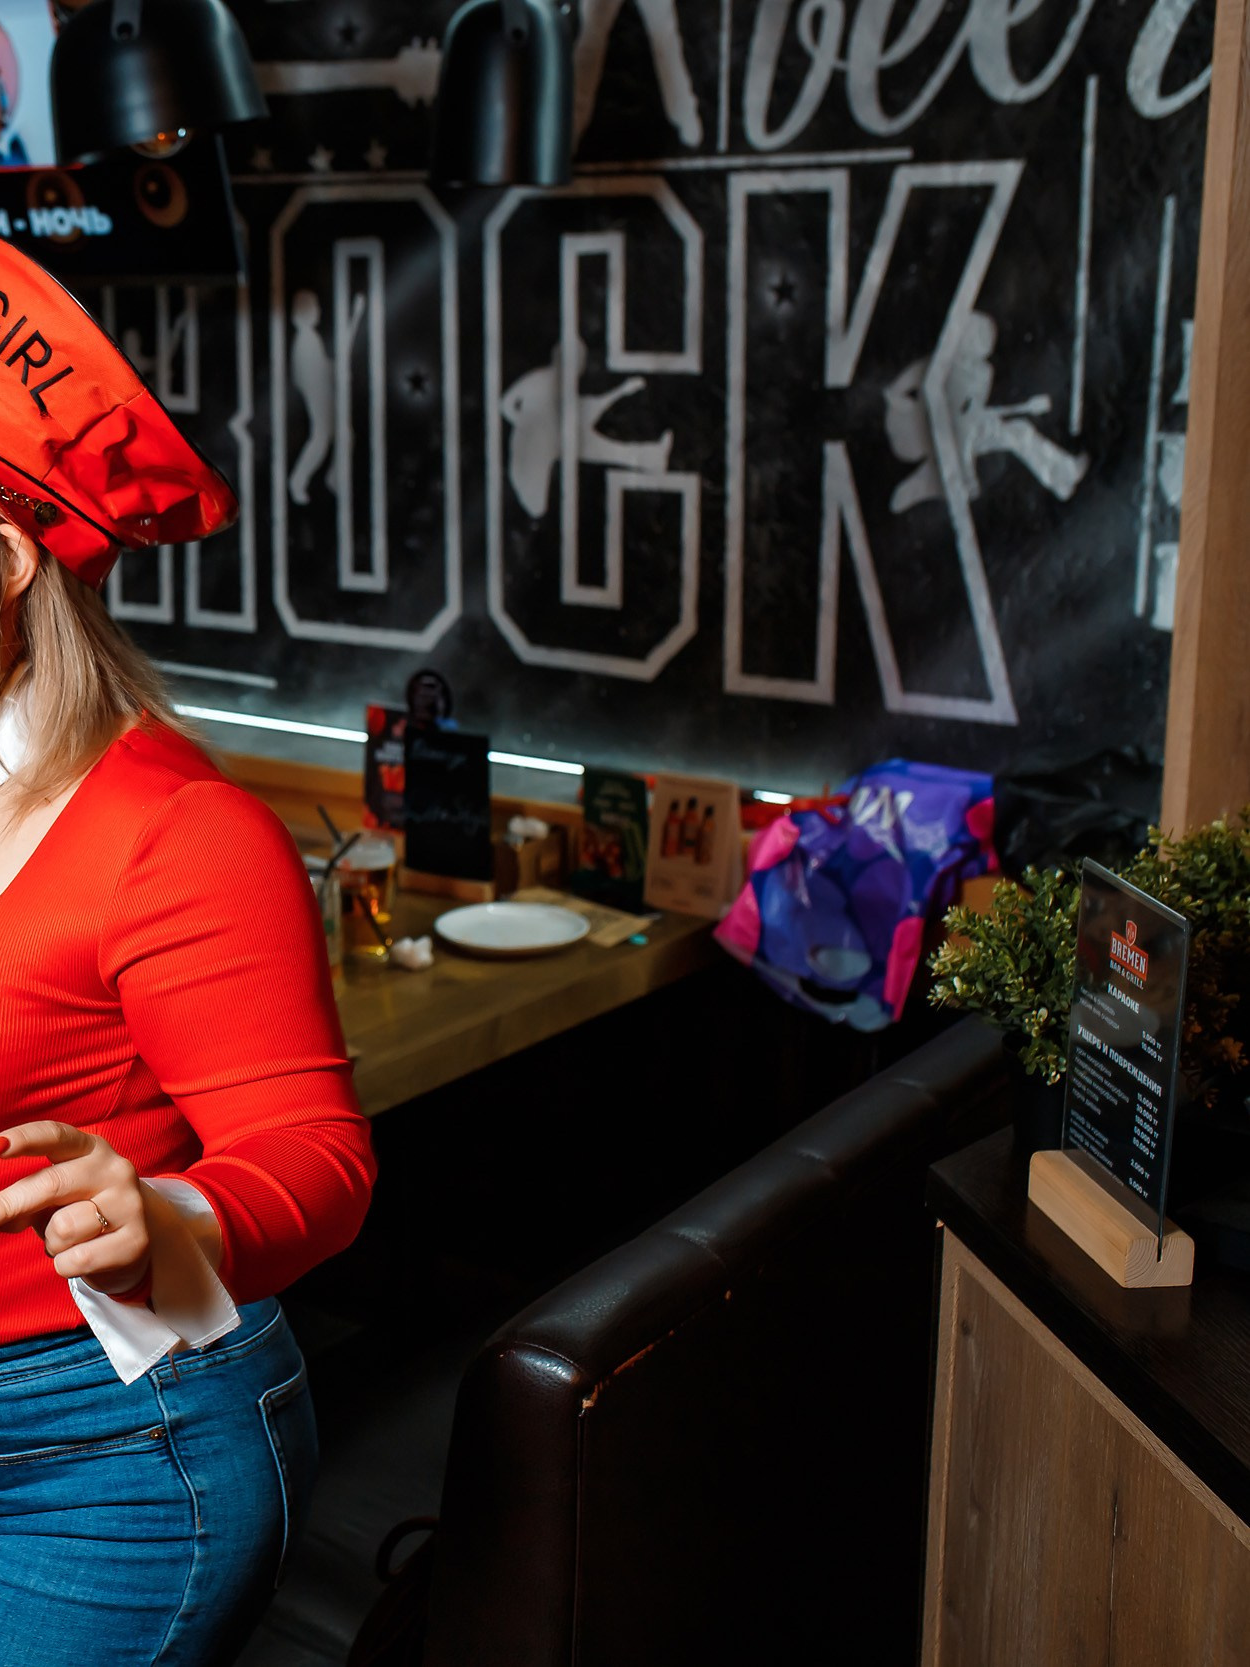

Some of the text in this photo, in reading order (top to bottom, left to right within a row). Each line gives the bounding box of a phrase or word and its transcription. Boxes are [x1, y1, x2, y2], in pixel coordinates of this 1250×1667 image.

[28, 206, 112, 236] НОЧЬ
[1111, 937, 1146, 974] BREMEN
[1110, 959, 1144, 990] BAR & GRILL
[1108, 982, 1139, 1014] КАРАОКЕ
[1077, 1023, 1102, 1051] УЩЕРБ
[1102, 1042, 1109, 1056] И
[1109, 1048, 1162, 1098] ПОВРЕЖДЕНИЯ
